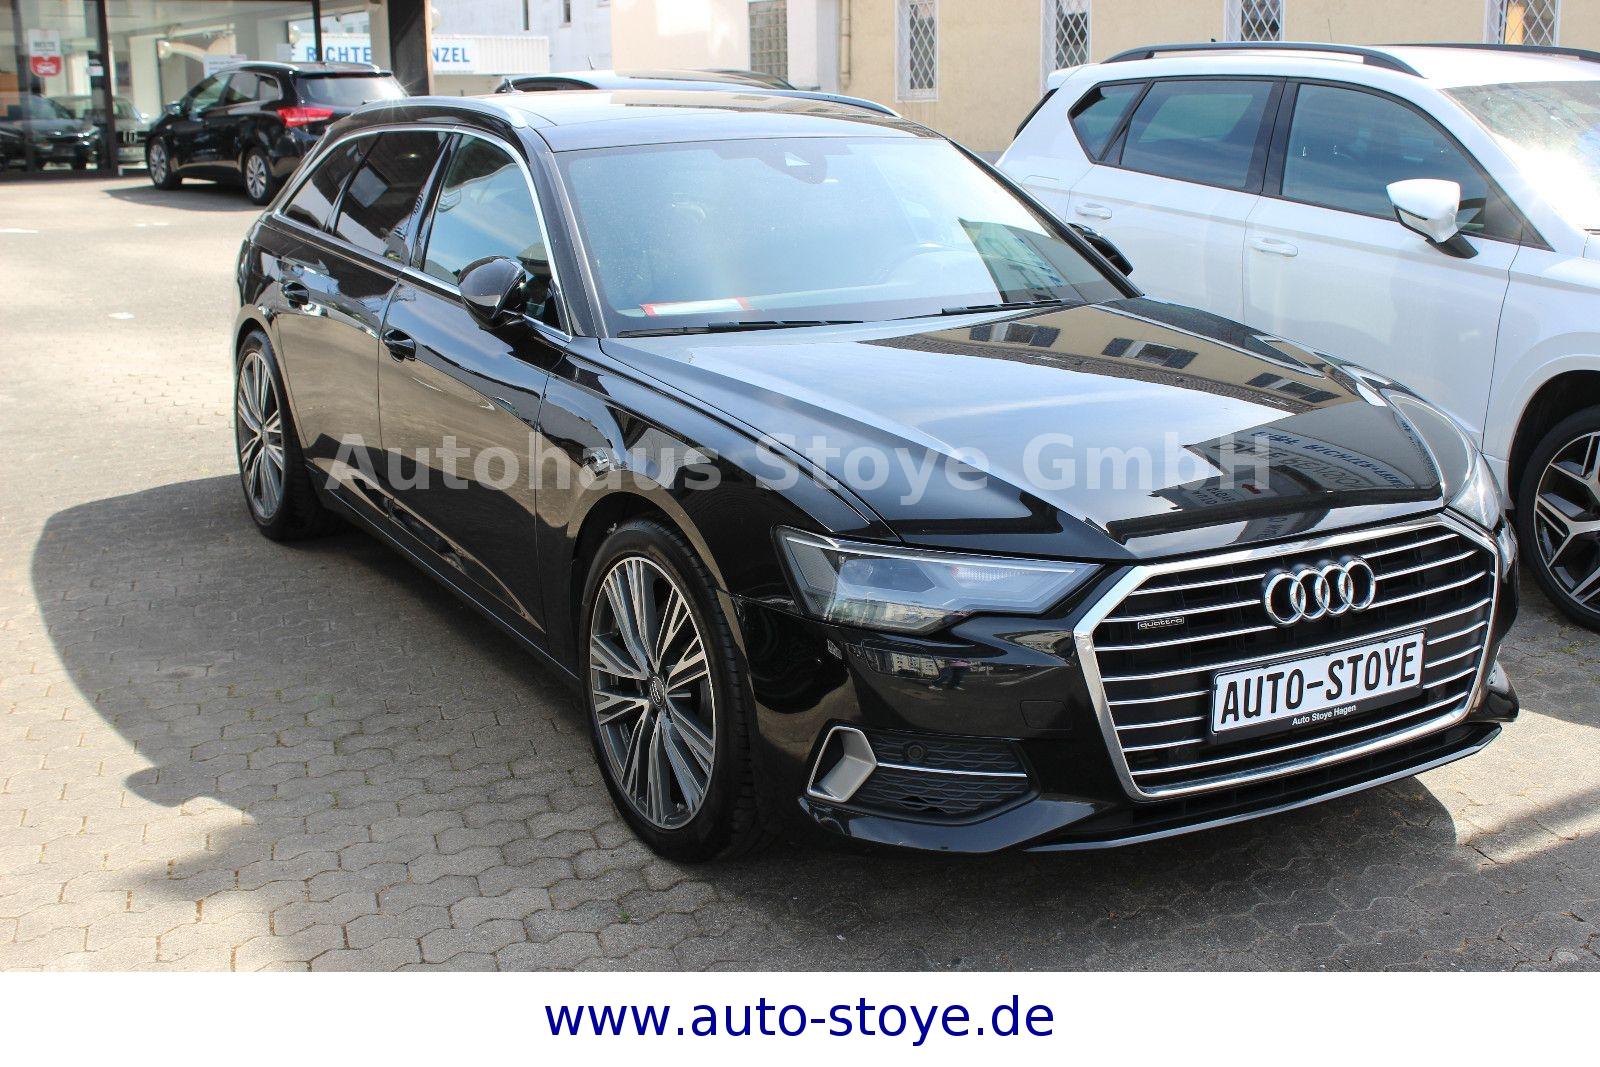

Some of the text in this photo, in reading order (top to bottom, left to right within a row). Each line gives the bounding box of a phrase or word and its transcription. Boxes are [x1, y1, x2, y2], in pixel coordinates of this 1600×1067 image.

[307, 46, 470, 62] RCHTE NZEL
[1139, 618, 1183, 629] quattro
[1221, 641, 1417, 724] AUTO-STOYE
[1292, 704, 1357, 726] Auto Stoye Hagen
